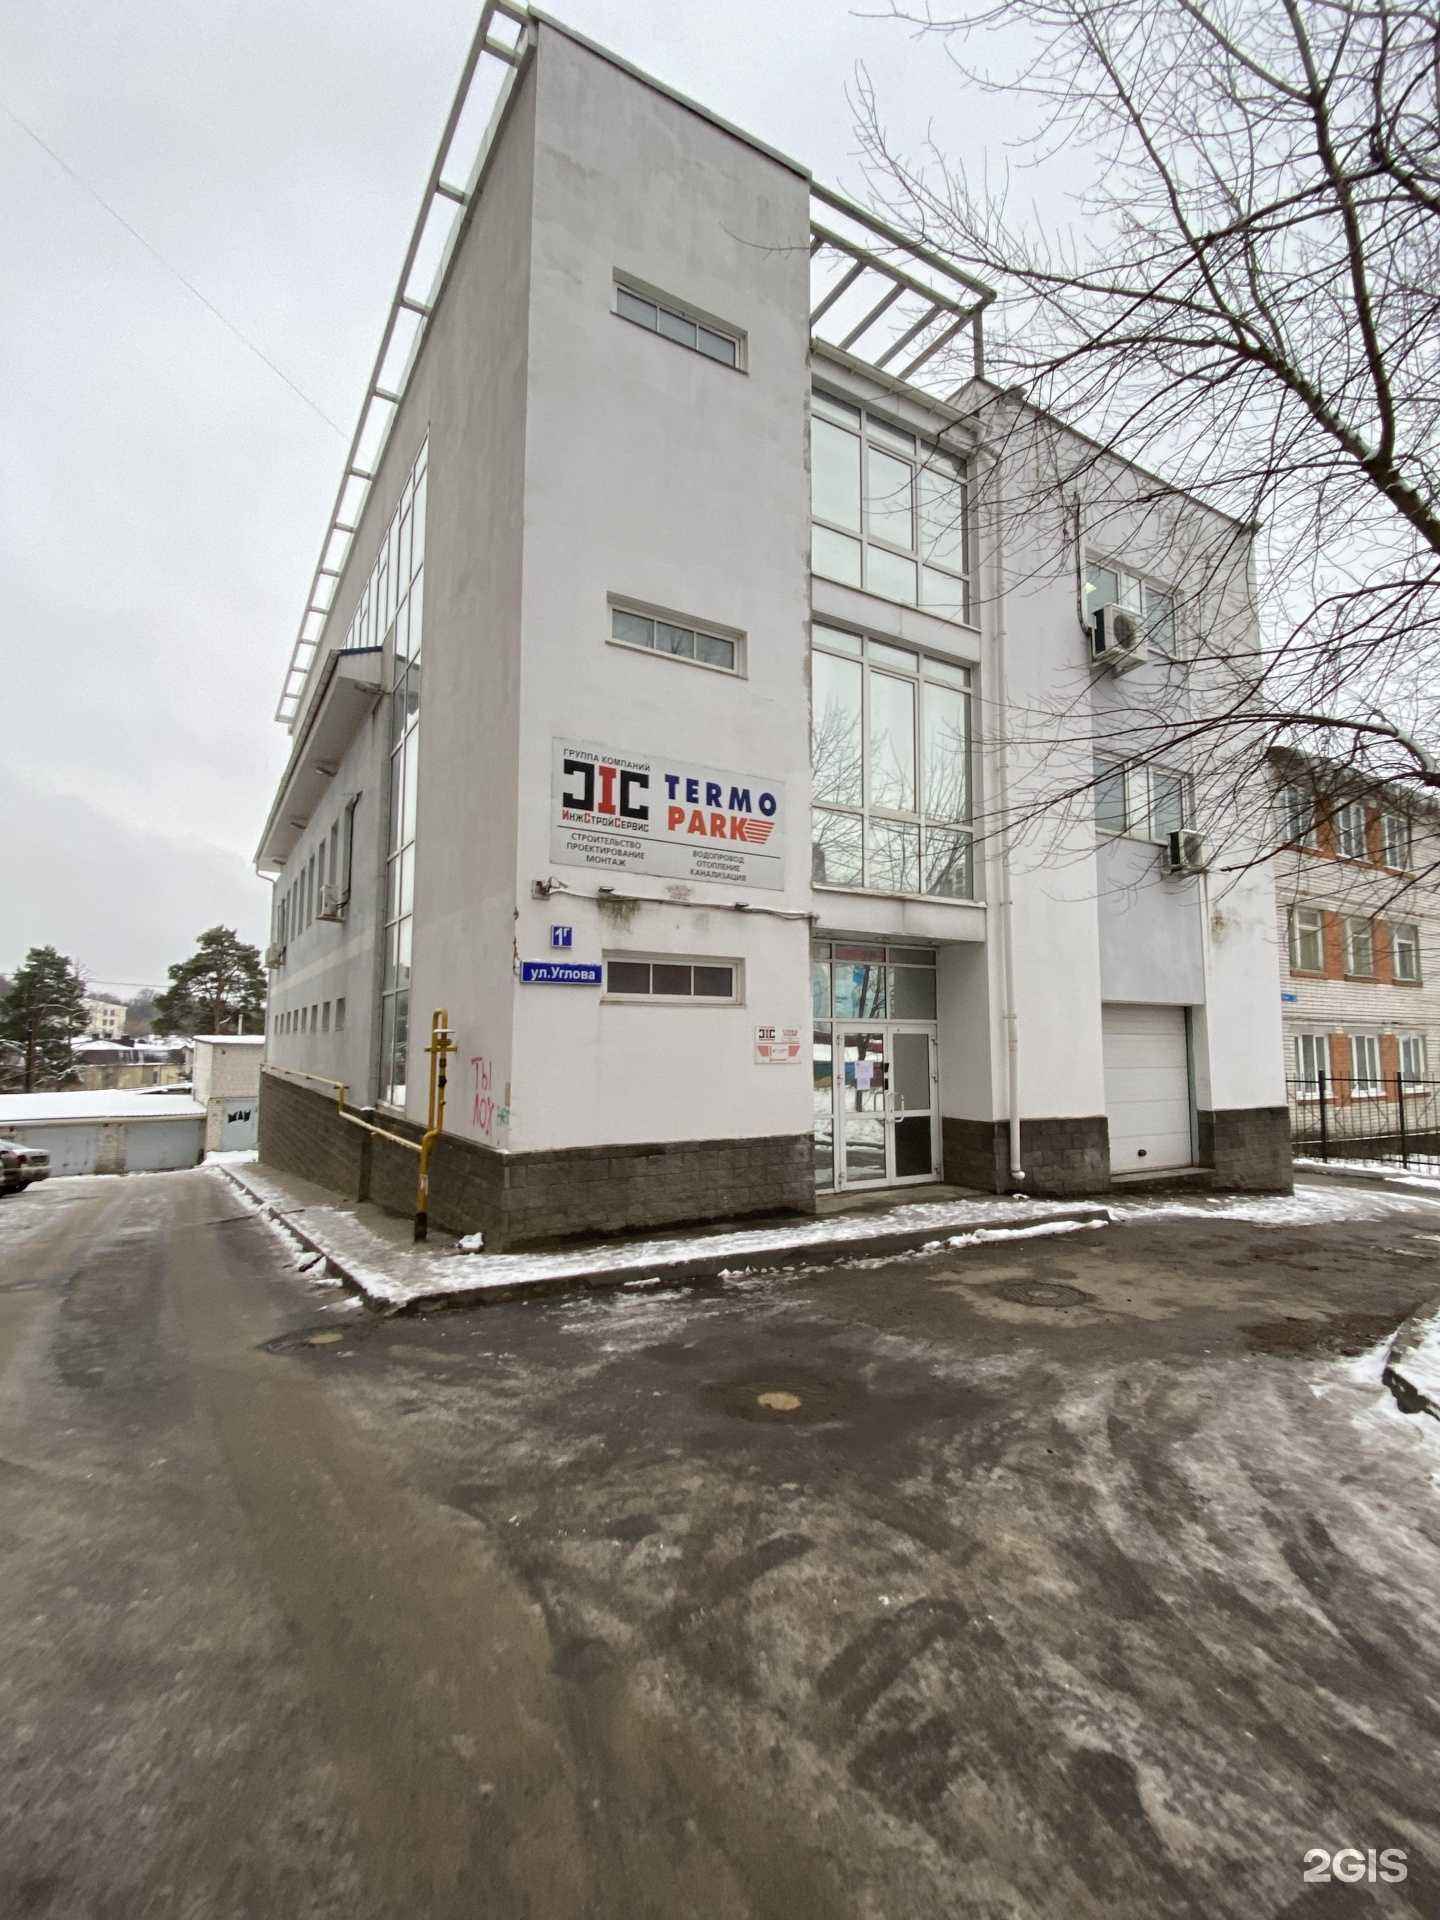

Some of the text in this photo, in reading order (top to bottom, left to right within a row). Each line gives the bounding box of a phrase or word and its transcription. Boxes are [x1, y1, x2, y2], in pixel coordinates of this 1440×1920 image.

[563, 748, 650, 772] ГРУППА КОМПАНИЙ
[664, 773, 777, 817] TERMO
[667, 805, 748, 842] PARK
[571, 832, 642, 849] СТРОИТЕЛЬСТВО
[566, 842, 645, 860] ПРОЕКТИРОВАНИЕ
[692, 850, 745, 865] ВОДОПРОВОД
[586, 855, 627, 867] МОНТАЖ
[696, 860, 741, 872] ОТОПЛЕНИЕ
